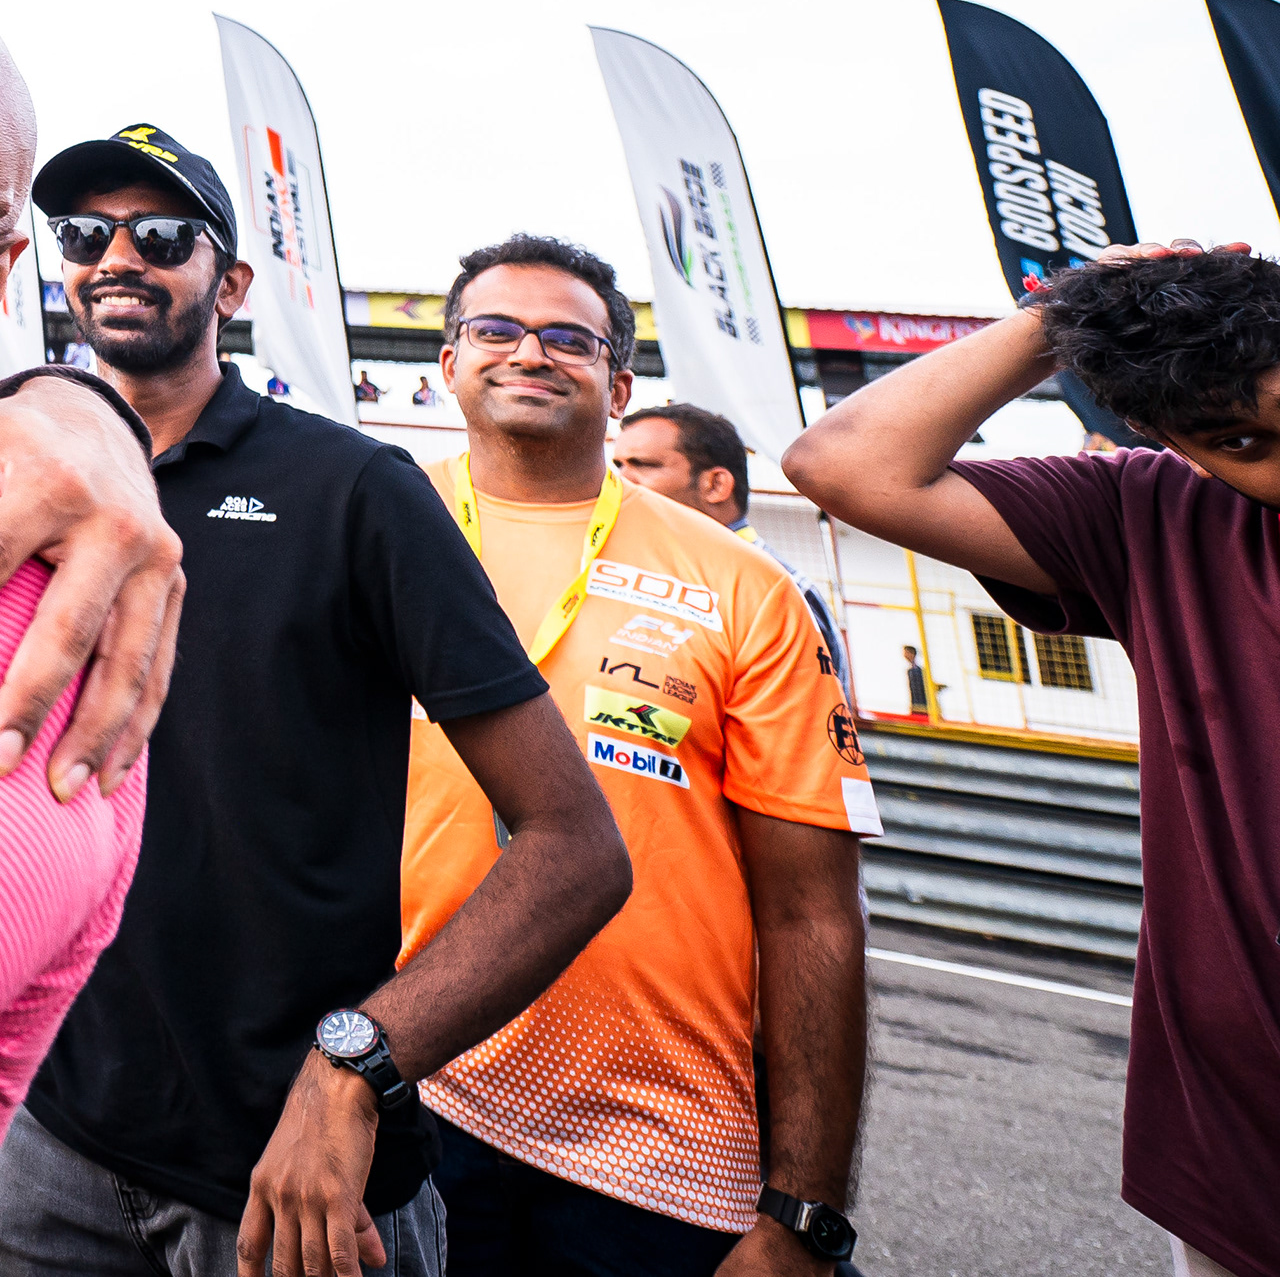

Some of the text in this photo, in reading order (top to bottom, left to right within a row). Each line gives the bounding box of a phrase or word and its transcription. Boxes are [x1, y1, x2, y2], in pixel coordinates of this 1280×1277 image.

[978, 87, 1061, 253] GODSPEED
[1045, 158, 1112, 262] KOCHI
[616, 628, 680, 653] INDIAN
[594, 740, 657, 774] Mobil
